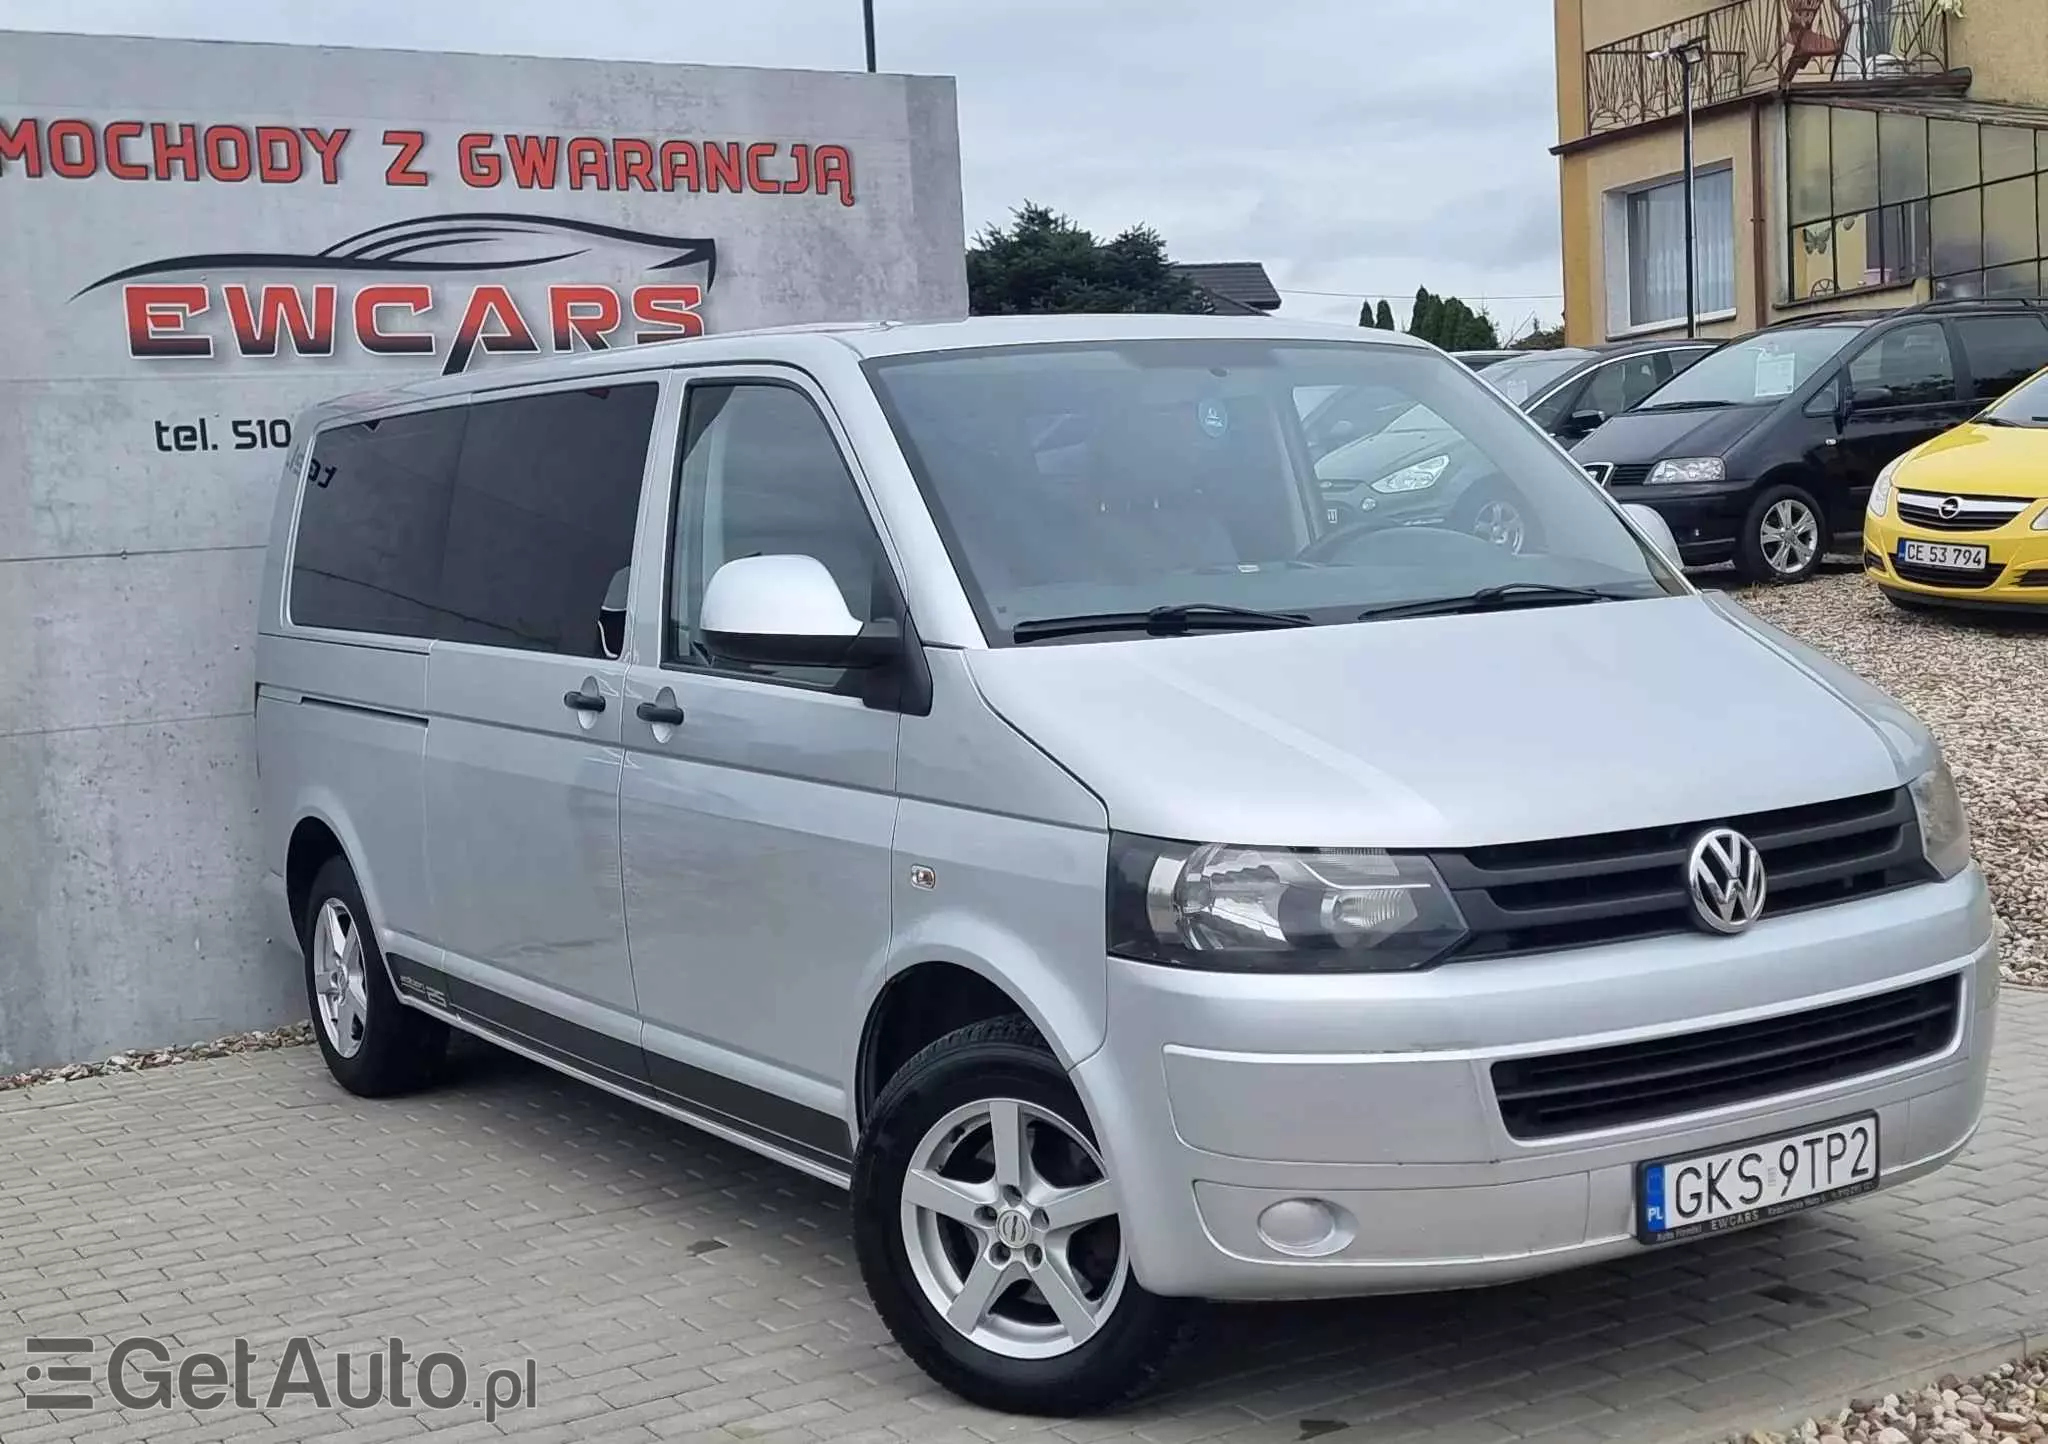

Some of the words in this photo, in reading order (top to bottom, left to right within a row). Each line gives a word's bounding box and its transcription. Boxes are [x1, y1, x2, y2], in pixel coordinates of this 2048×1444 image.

[0, 117, 350, 185] MOCHODY
[384, 131, 429, 187] Z
[459, 132, 855, 206] GWARANCJĄ
[125, 283, 705, 375] EWCARS
[154, 418, 219, 452] tel.
[231, 418, 291, 449] 510
[1907, 543, 1924, 561] CE
[1929, 546, 1947, 563] 53
[1953, 548, 1983, 567] 794
[1675, 1153, 1763, 1218] GKS
[1779, 1126, 1869, 1197] 9TP2
[1647, 1206, 1664, 1222] PL
[1711, 1210, 1759, 1231] EWCARS
